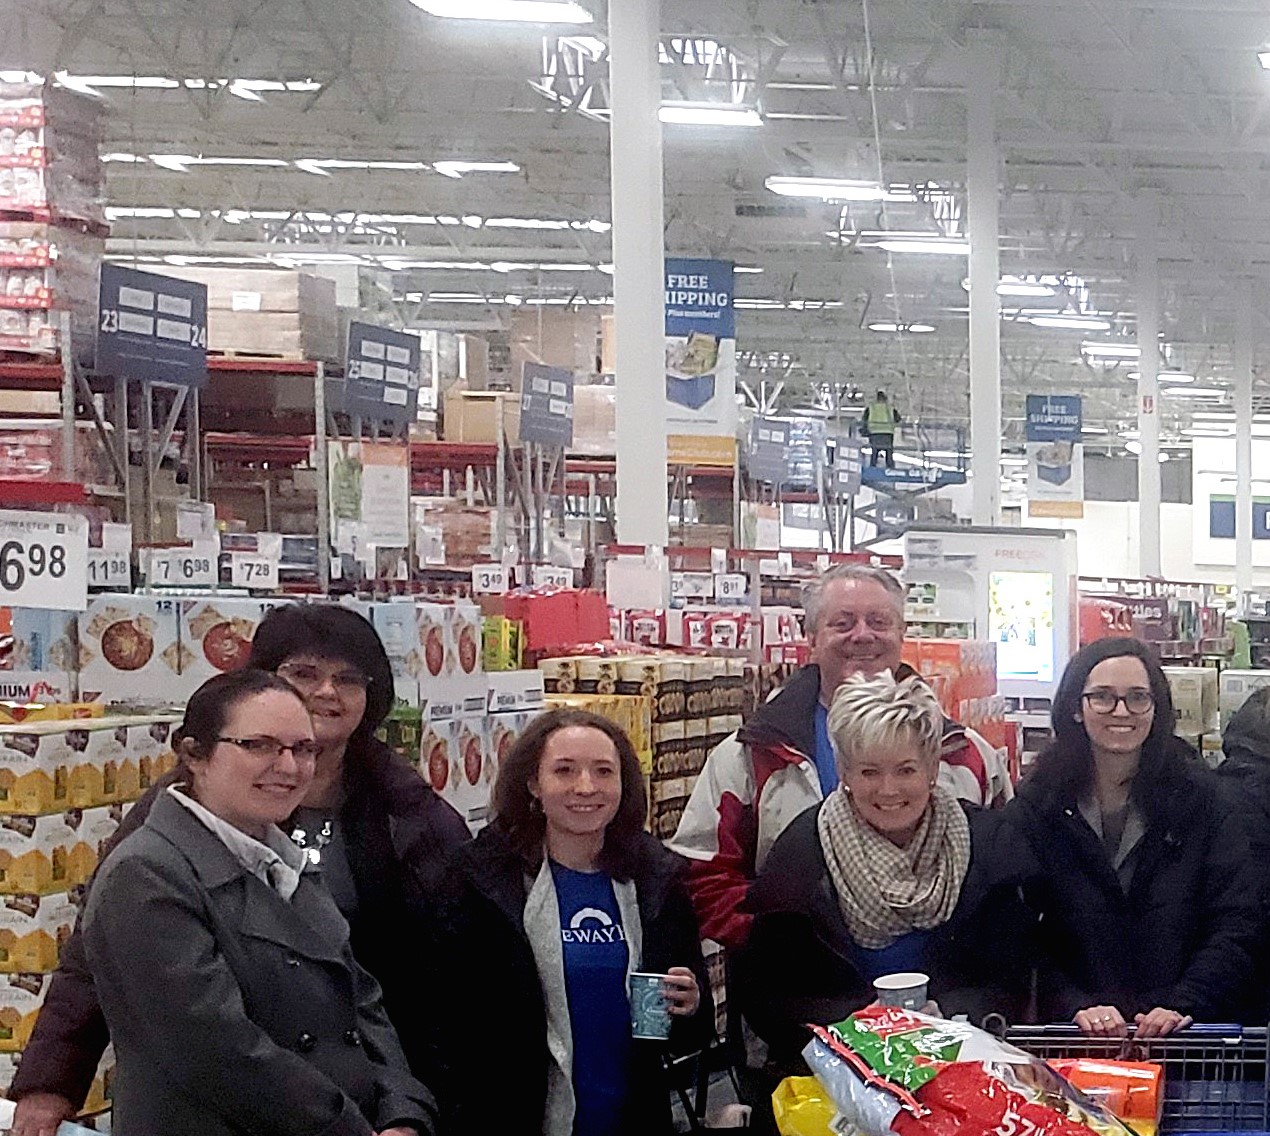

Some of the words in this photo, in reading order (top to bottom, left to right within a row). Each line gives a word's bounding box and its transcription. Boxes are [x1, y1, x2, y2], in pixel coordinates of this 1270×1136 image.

[668, 274, 708, 288] FREE
[665, 291, 728, 306] IPPING
[101, 309, 118, 333] 23
[190, 326, 206, 349] 24
[156, 600, 171, 609] 12
[562, 924, 627, 943] EWAY
